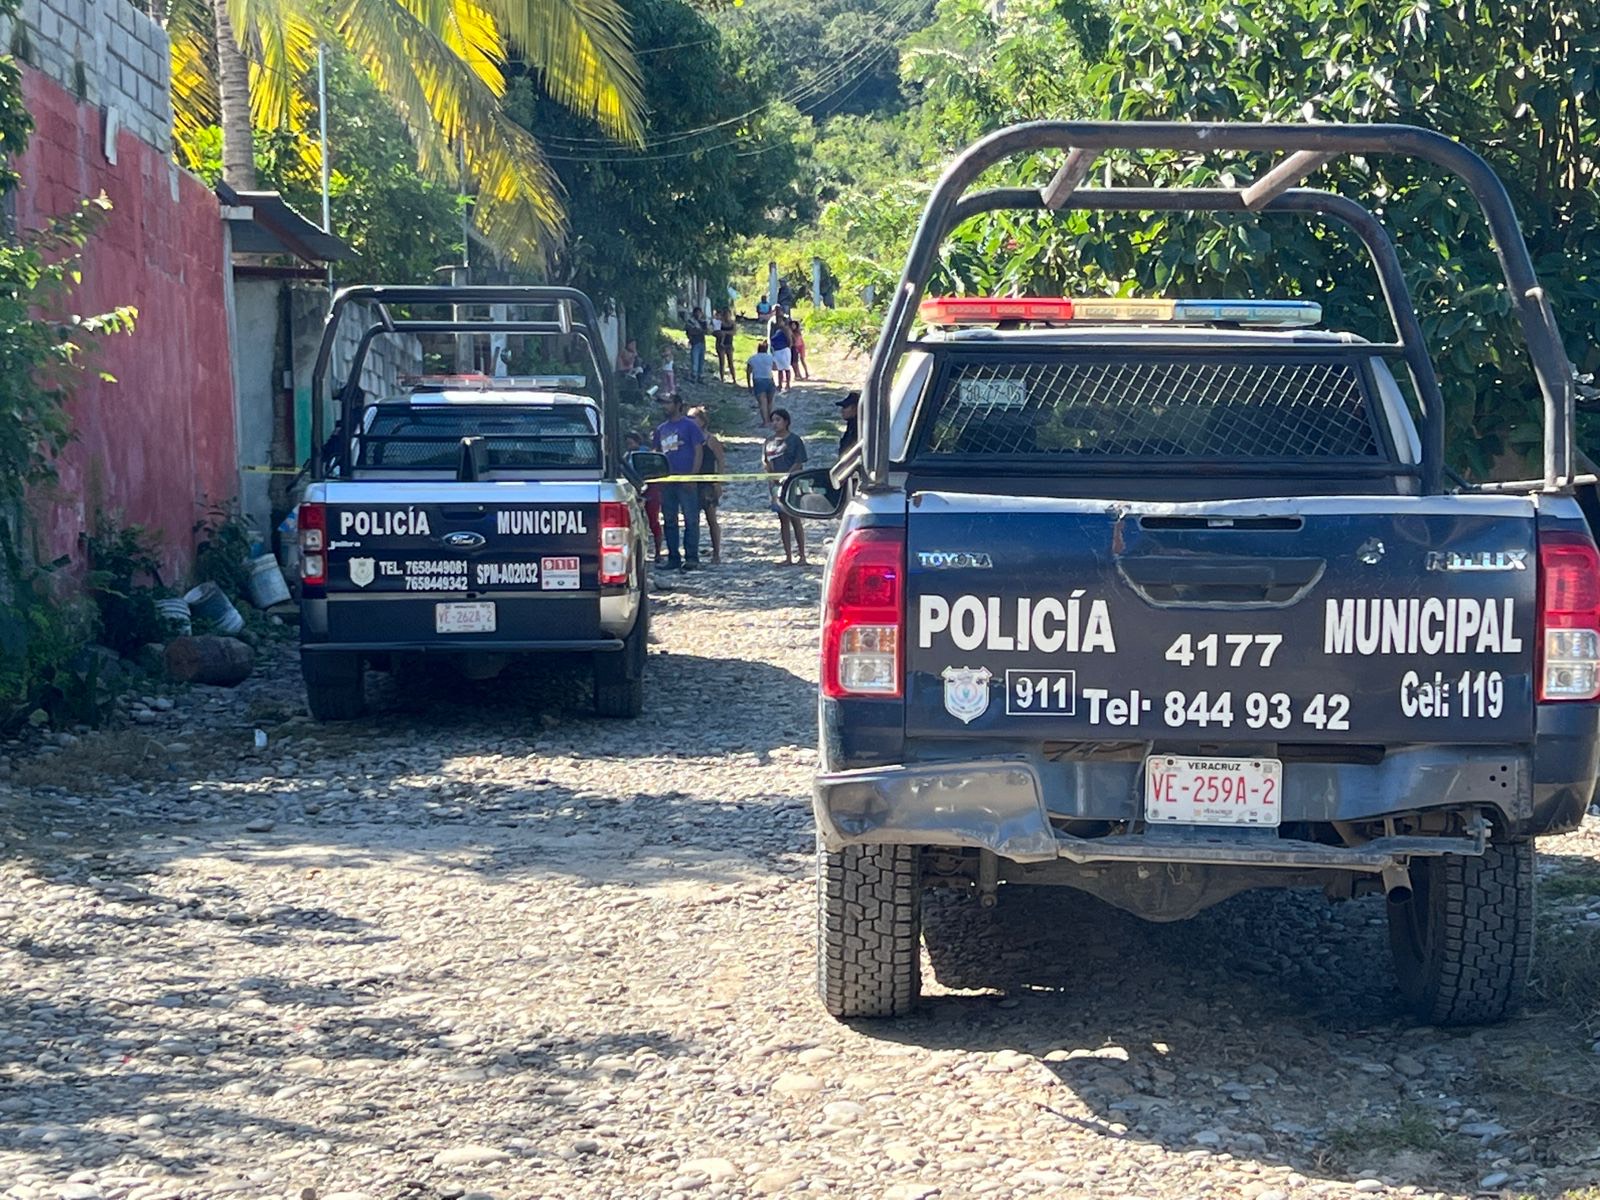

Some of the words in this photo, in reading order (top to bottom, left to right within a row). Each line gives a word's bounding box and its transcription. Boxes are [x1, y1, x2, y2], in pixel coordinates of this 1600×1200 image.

[340, 506, 431, 536] POLICÍA
[497, 510, 587, 535] MUNICIPAL
[451, 534, 475, 545] Ford
[379, 561, 403, 575] TEL.
[544, 560, 576, 570] 911
[918, 552, 993, 569] TOYOTA
[919, 589, 1116, 653] POLICÍA
[1324, 597, 1522, 655] MUNICIPAL
[1165, 633, 1283, 667] 4177
[1015, 676, 1067, 709] 911
[1458, 671, 1504, 718] 119
[1164, 691, 1234, 728] 844
[1245, 692, 1292, 729] 93
[1303, 693, 1350, 730] 42
[1188, 761, 1241, 771] VERACRUZ
[1152, 773, 1275, 805] VE-259A-2
